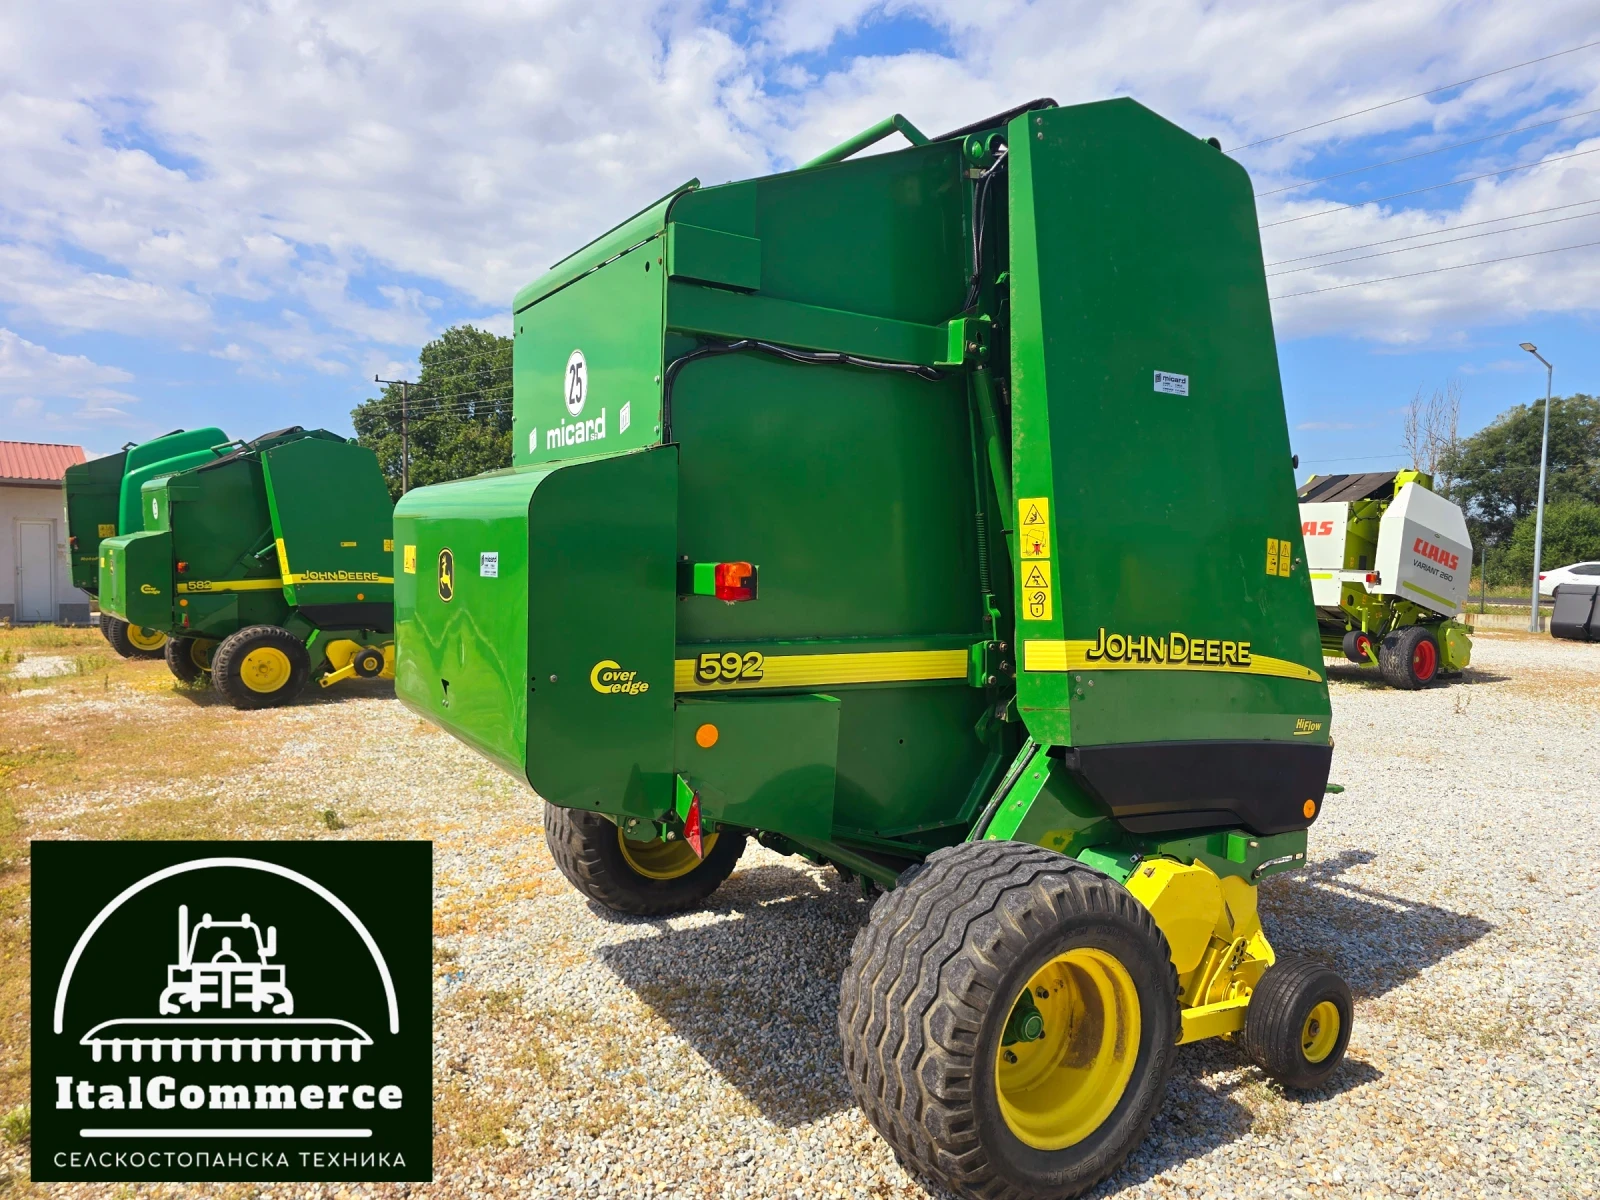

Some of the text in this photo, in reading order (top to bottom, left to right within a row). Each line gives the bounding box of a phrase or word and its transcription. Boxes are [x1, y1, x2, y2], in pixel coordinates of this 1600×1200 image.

[569, 362, 582, 404] 25
[546, 407, 606, 450] micard
[1413, 537, 1459, 571] CLAAS
[187, 580, 212, 591] 582
[302, 569, 379, 581] JOHN DEERE
[1413, 559, 1454, 582] VARIANT 260
[1087, 627, 1252, 664] JOHN DEERE
[590, 659, 637, 694] Cover
[697, 651, 764, 682] 592
[611, 681, 650, 695] edge
[1295, 717, 1323, 731] HiFlow
